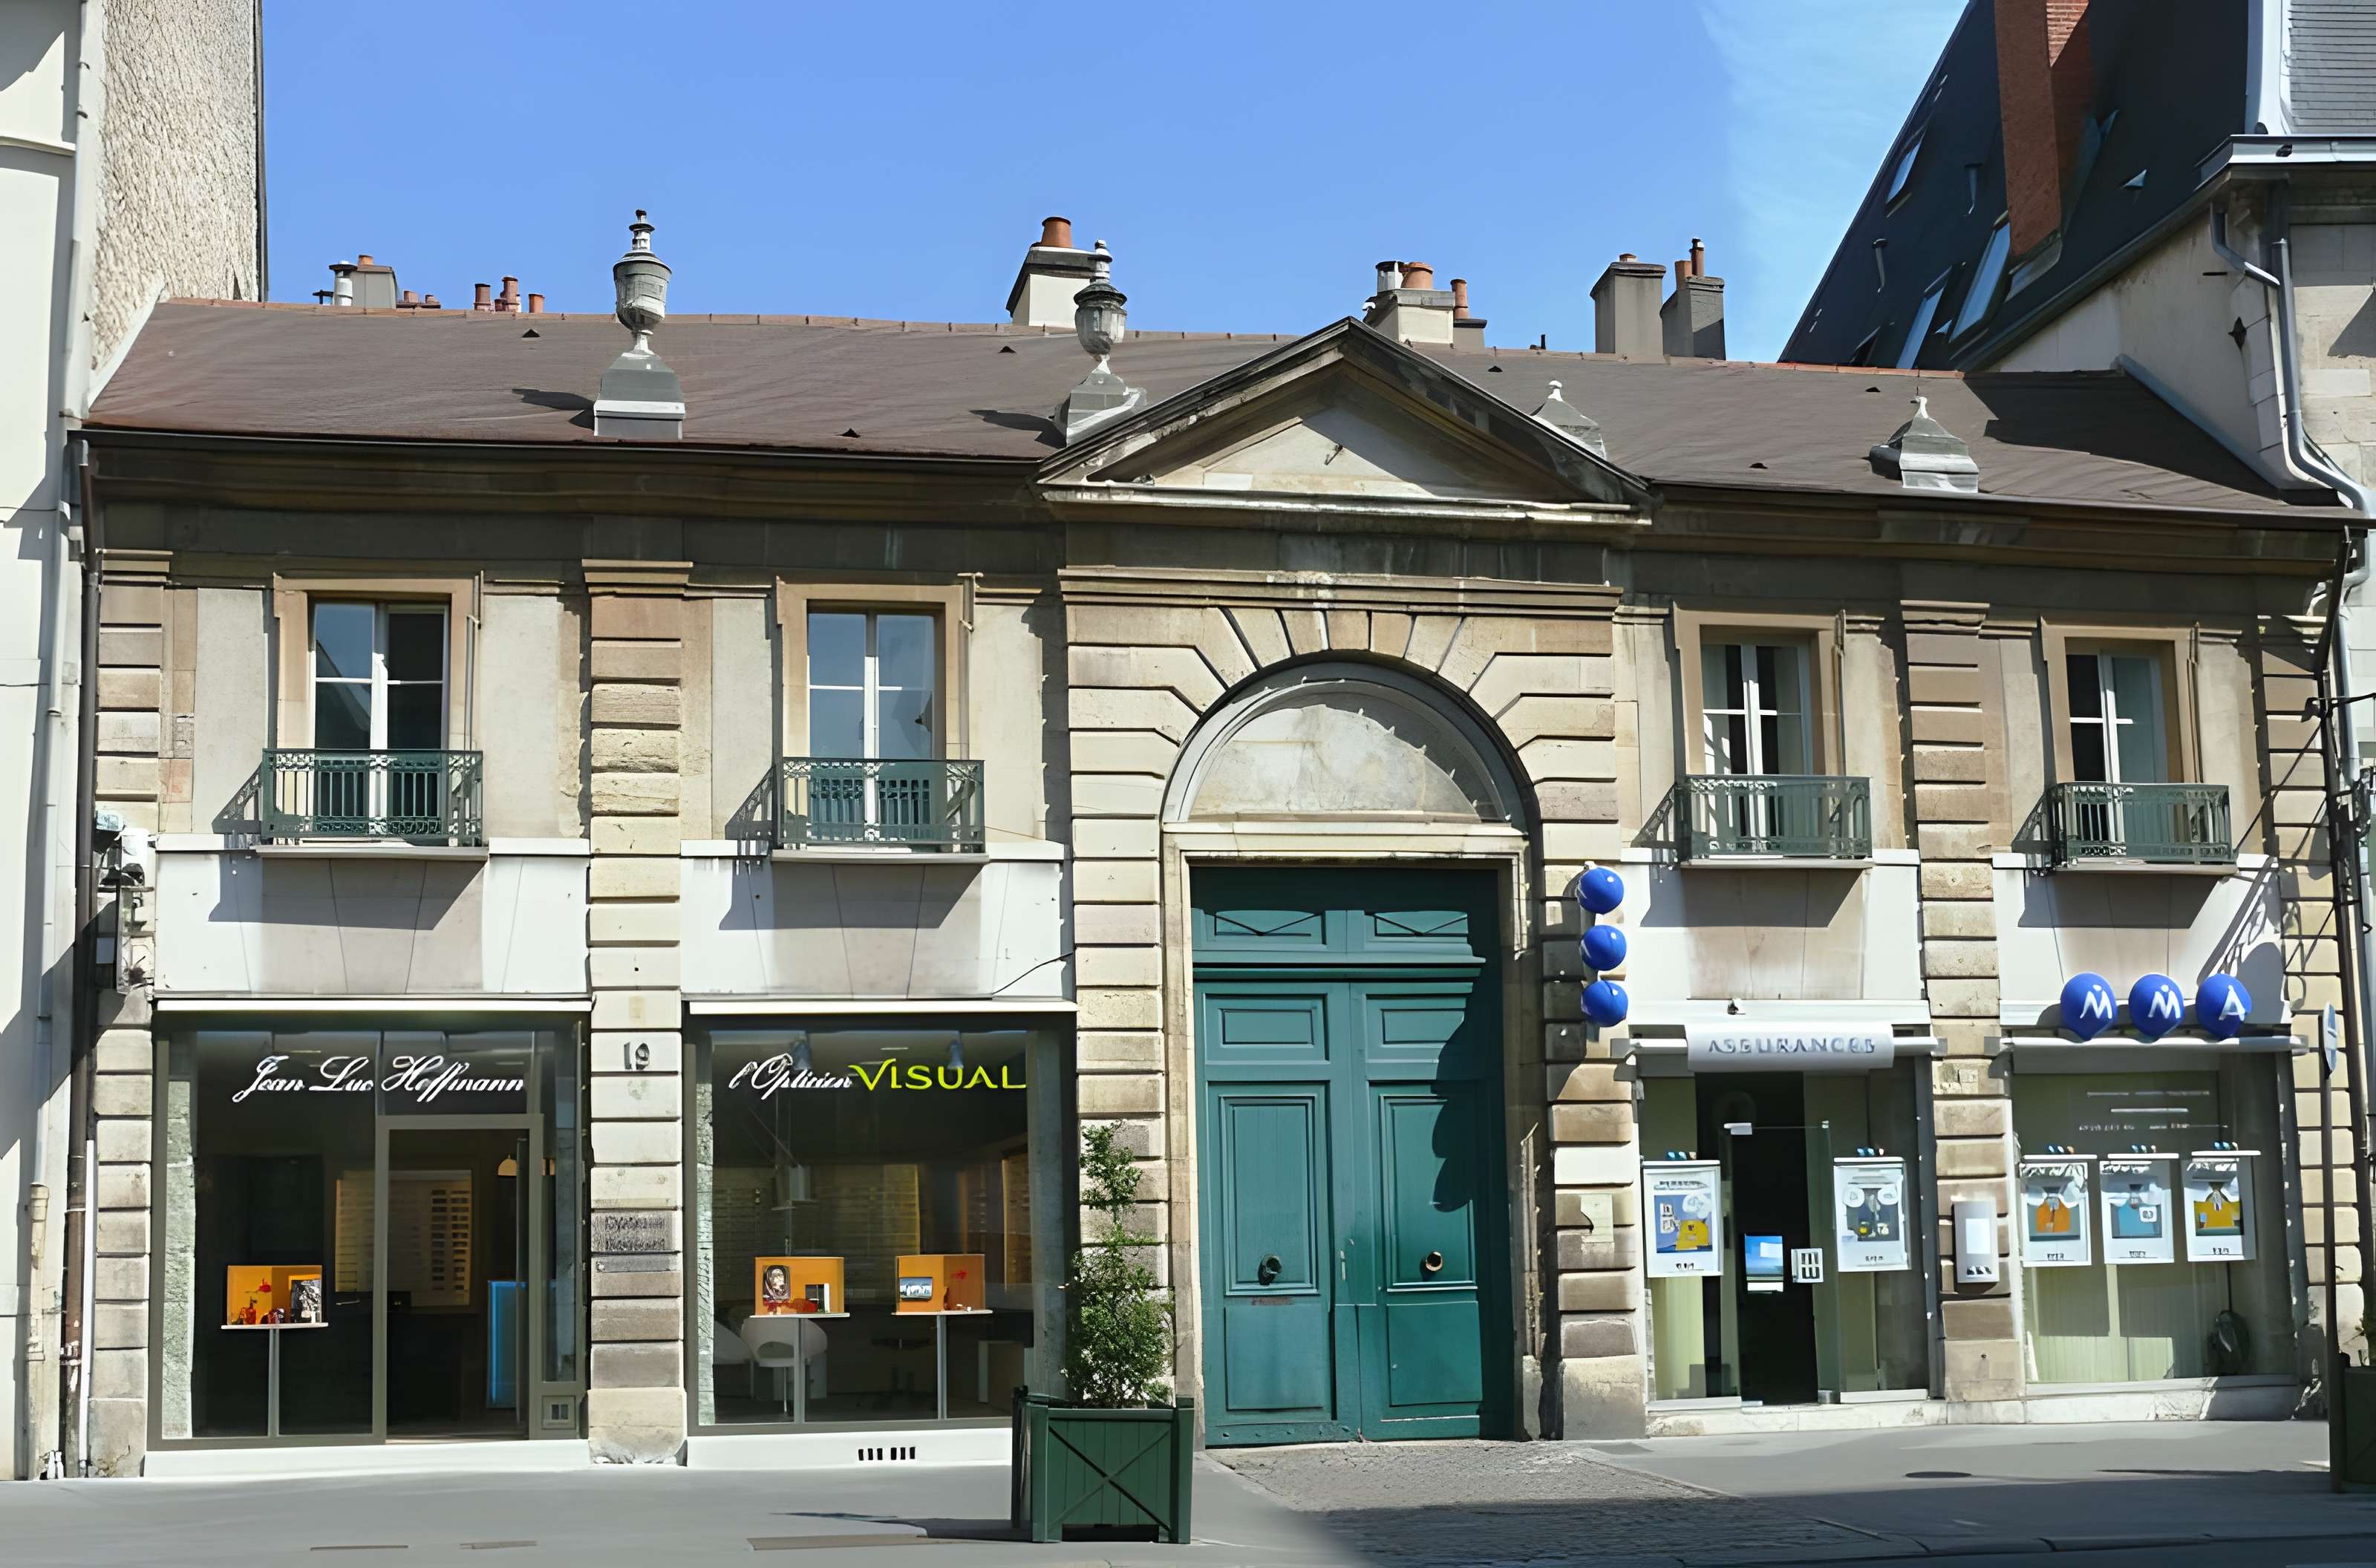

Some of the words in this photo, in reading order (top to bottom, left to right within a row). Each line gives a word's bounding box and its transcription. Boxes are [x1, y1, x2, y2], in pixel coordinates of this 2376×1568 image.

[623, 1042, 650, 1071] 19
[1708, 1038, 1876, 1054] ASSURANCES
[232, 1055, 304, 1102] Jean
[309, 1056, 373, 1091] Luc
[381, 1055, 523, 1102] Hoffmann
[848, 1058, 1027, 1091] VISUAL
